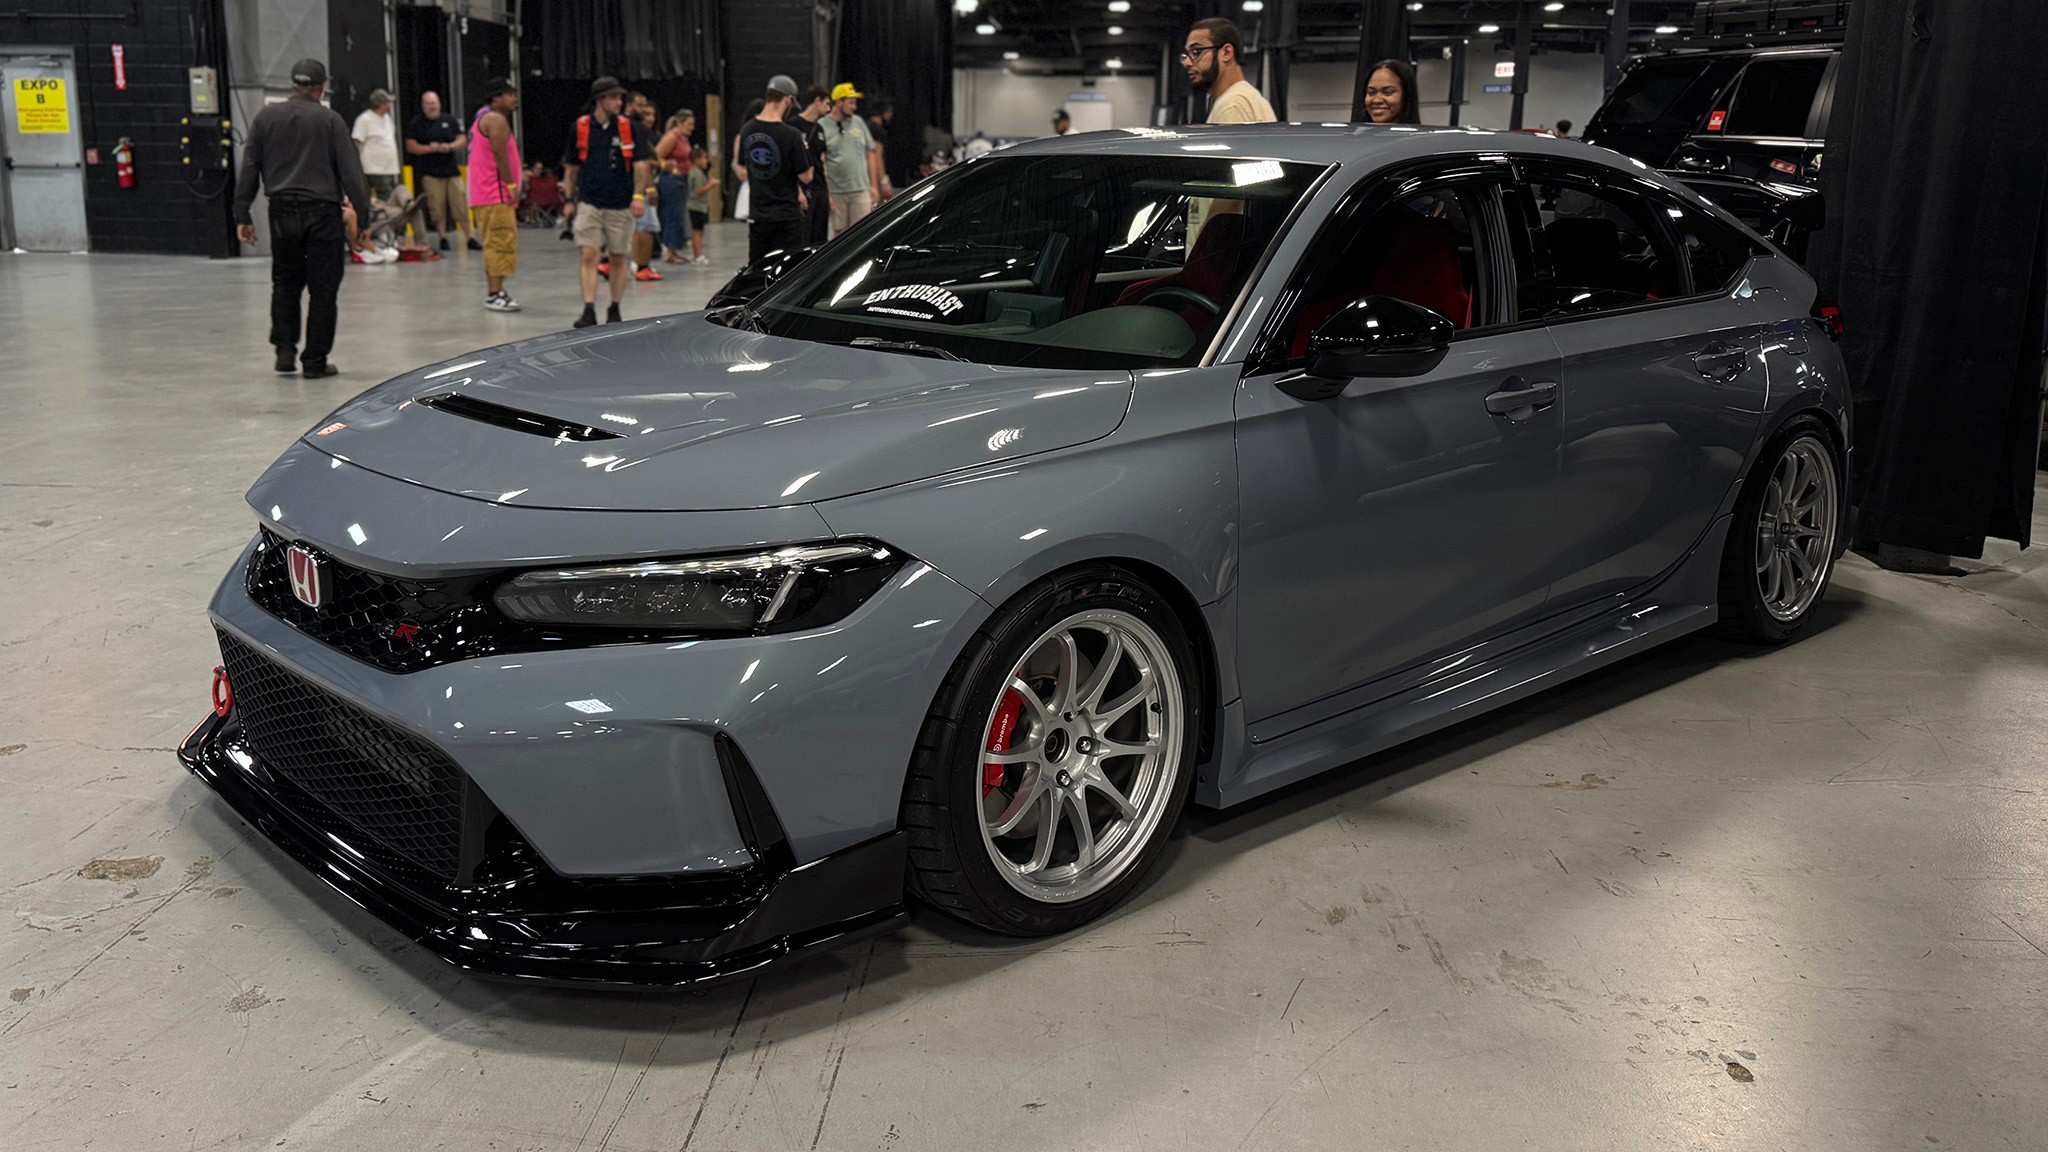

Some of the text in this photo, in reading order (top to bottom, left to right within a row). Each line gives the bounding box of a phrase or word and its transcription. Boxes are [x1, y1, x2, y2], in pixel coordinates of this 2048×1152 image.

[21, 79, 58, 90] EXPO
[36, 93, 46, 104] B
[862, 284, 964, 317] ENTHUSIAST
[997, 713, 1009, 743] brembo
